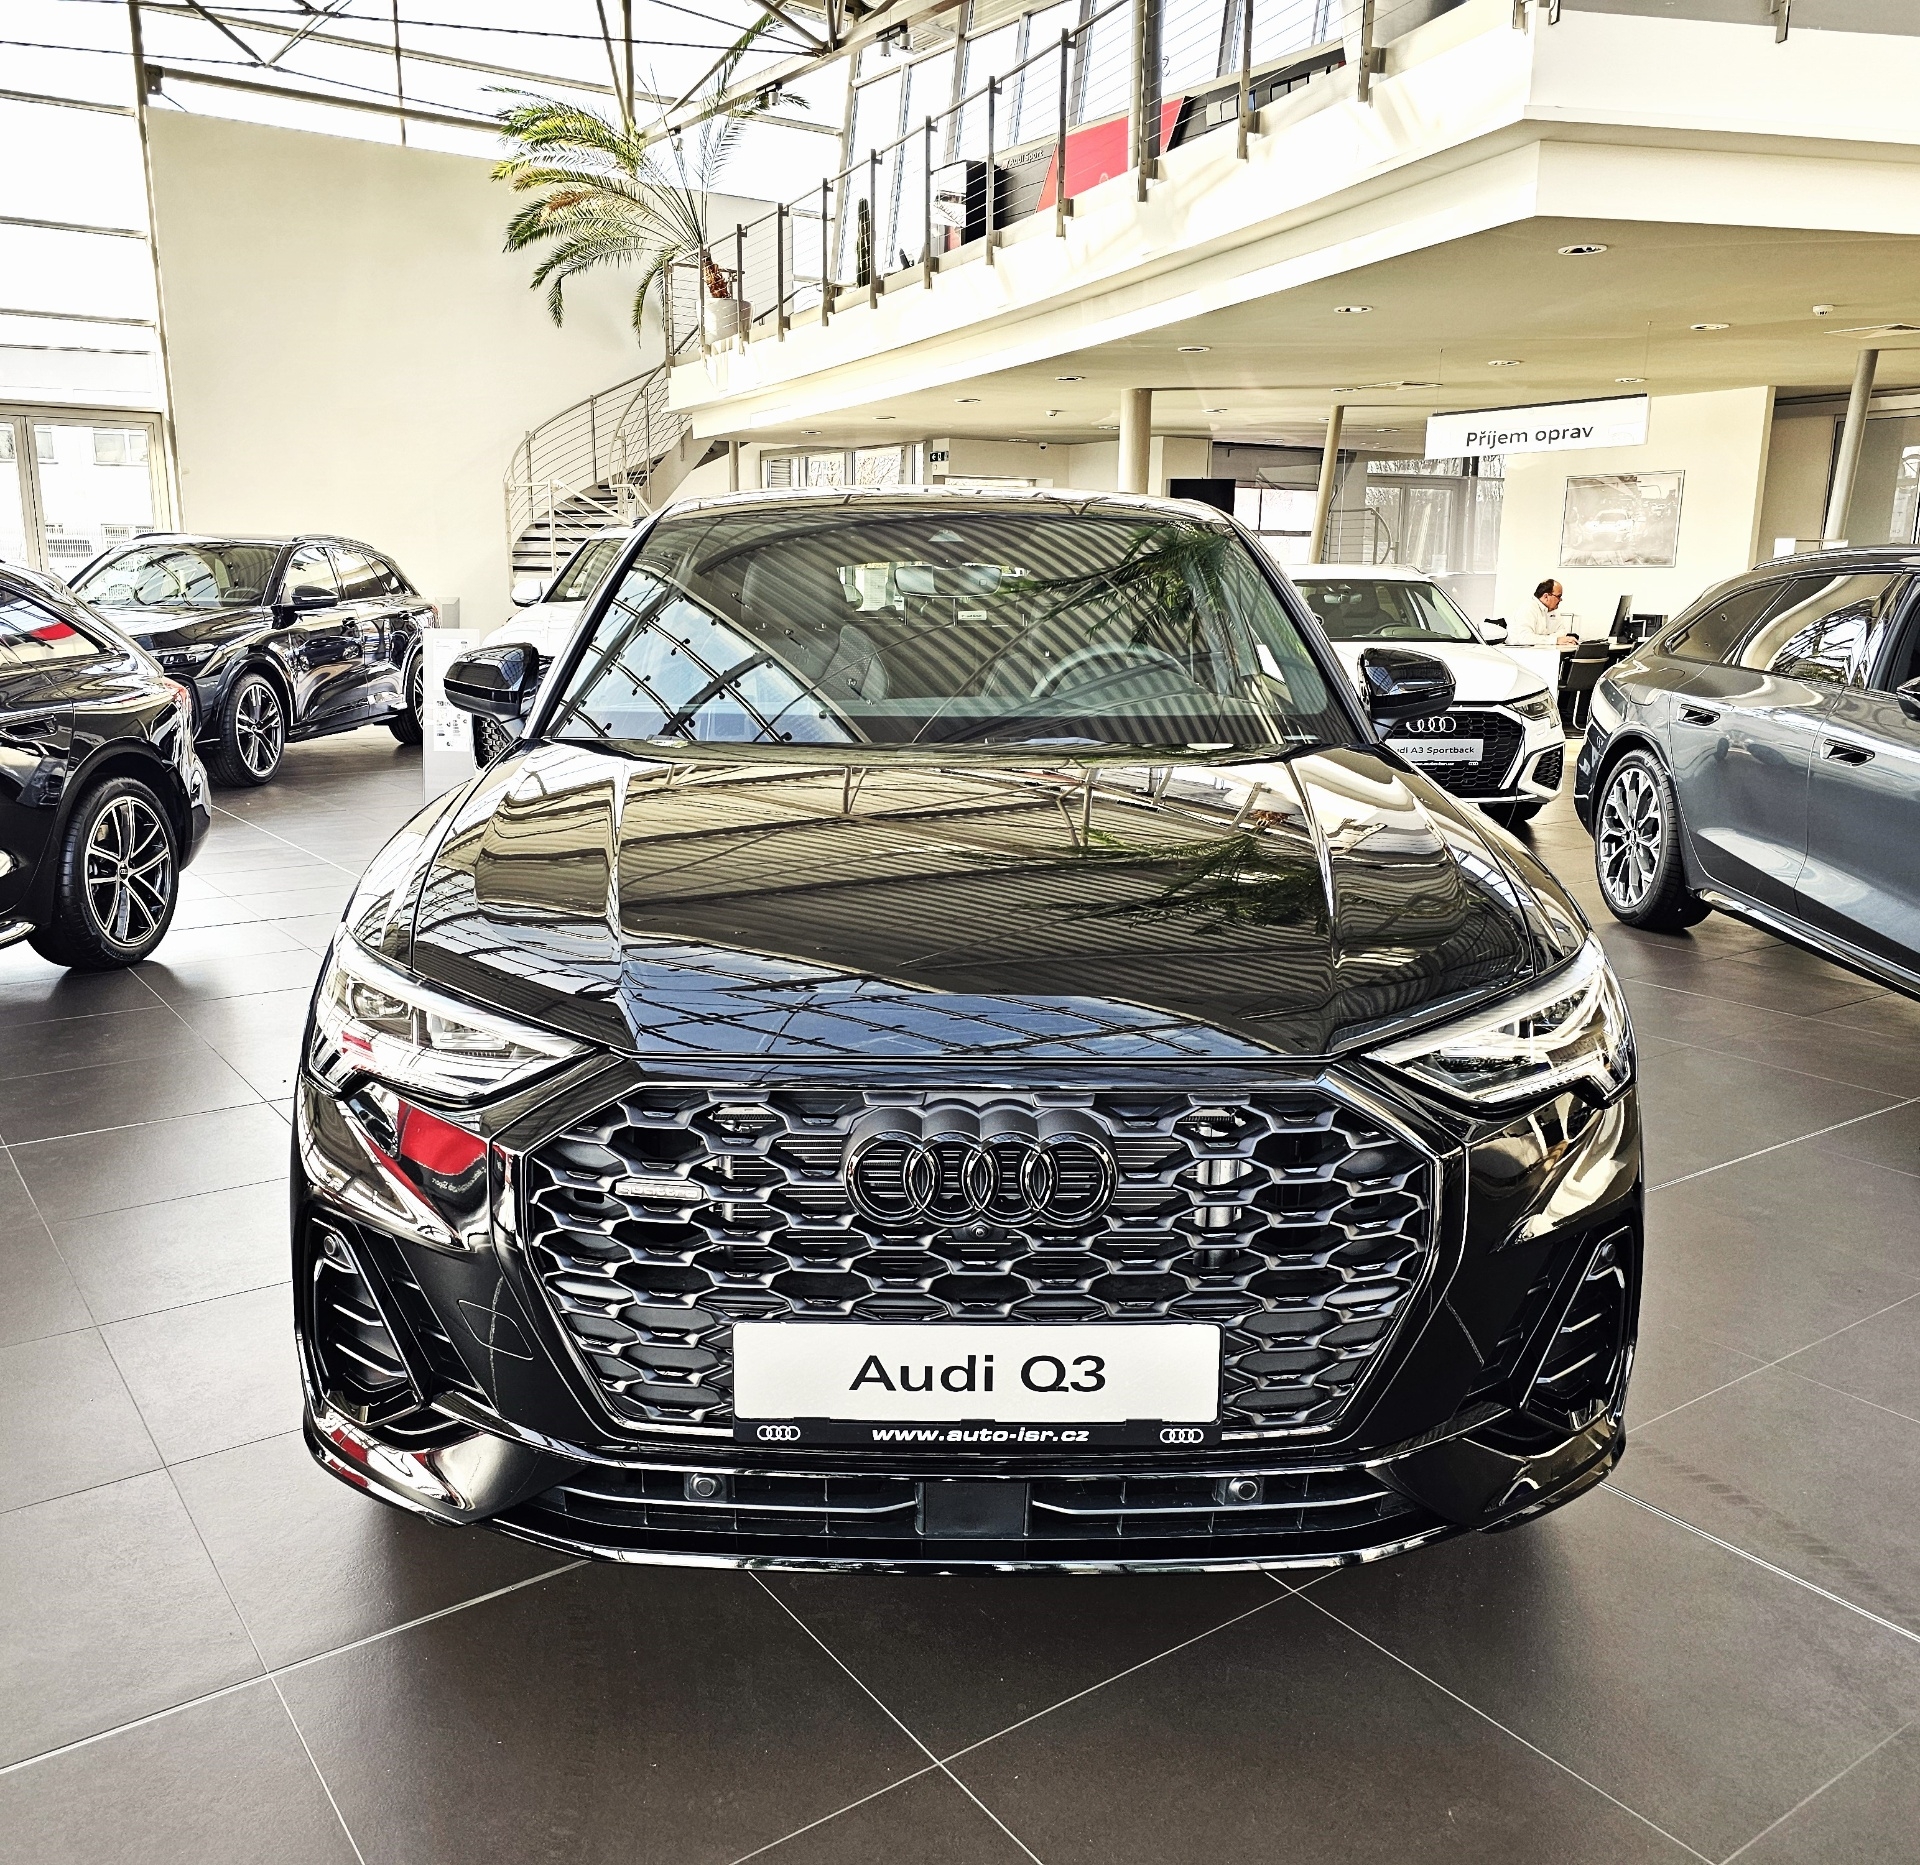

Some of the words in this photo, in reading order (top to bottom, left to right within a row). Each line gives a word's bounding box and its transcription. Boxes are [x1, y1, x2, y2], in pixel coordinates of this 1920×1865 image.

[1009, 154, 1025, 166] Audi
[1025, 150, 1043, 163] Sport
[1466, 430, 1528, 449] Příjem
[1535, 426, 1594, 445] oprav
[1426, 746, 1475, 755] Sportback
[620, 1185, 698, 1199] quattro
[848, 1354, 994, 1393] Audi
[1020, 1354, 1106, 1393] Q3
[872, 1427, 1090, 1442] www.auto-isr.cz
